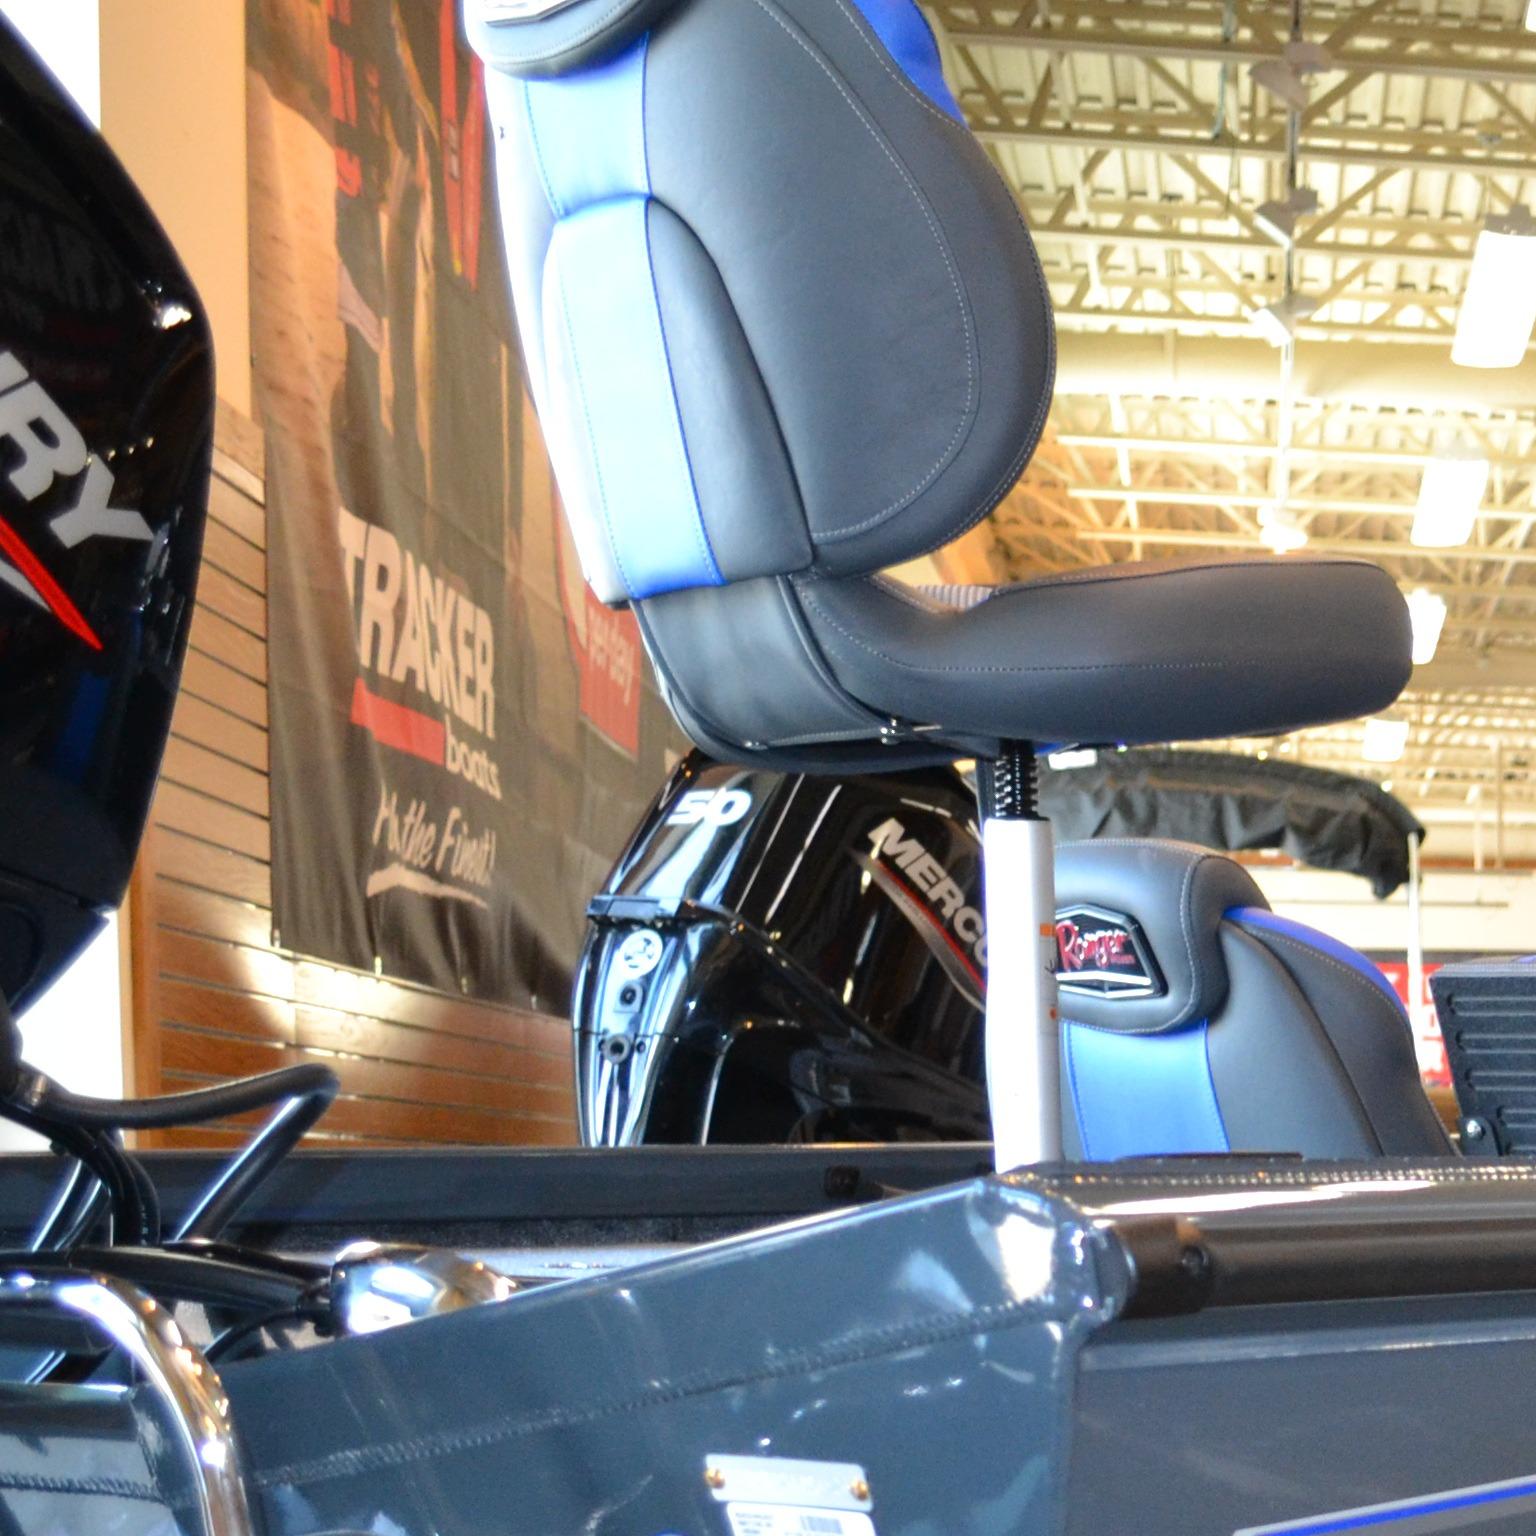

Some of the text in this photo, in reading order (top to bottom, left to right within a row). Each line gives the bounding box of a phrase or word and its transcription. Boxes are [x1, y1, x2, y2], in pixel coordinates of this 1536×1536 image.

[0, 350, 154, 549] RY
[338, 506, 496, 740] TRACKER
[444, 714, 503, 800] boats
[665, 789, 752, 827] 50
